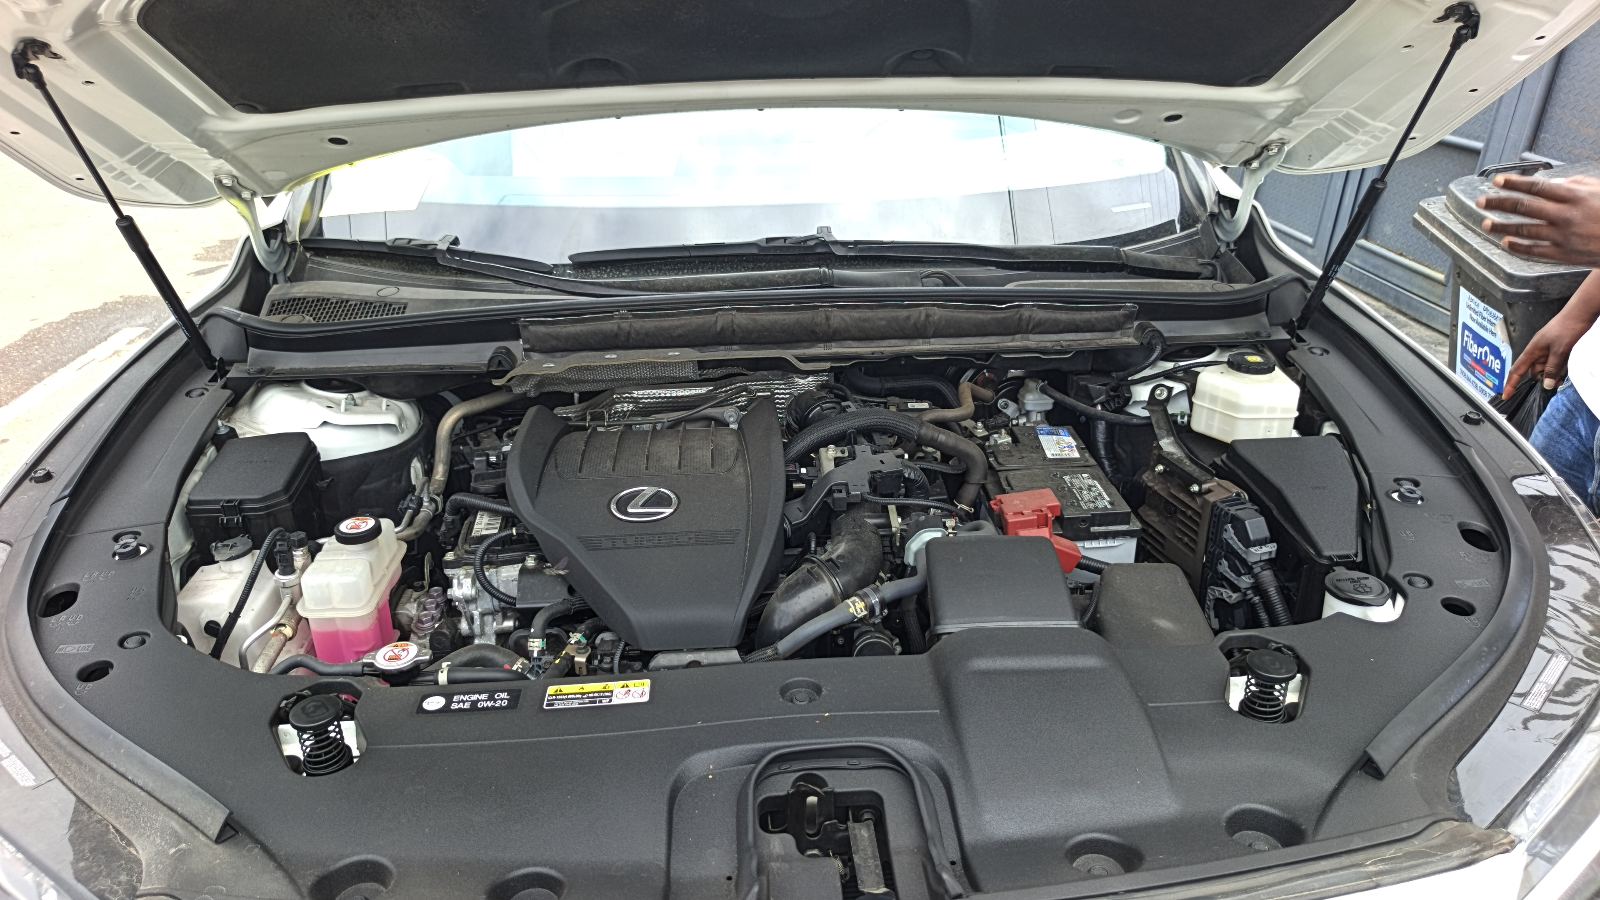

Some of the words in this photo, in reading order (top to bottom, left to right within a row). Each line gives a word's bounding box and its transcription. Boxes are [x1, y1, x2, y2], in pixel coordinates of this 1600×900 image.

[1463, 329, 1501, 374] FiberOne
[452, 693, 489, 702] ENGINE
[494, 692, 511, 700] OIL
[450, 701, 471, 710] SAE
[477, 699, 508, 709] 0W-20
